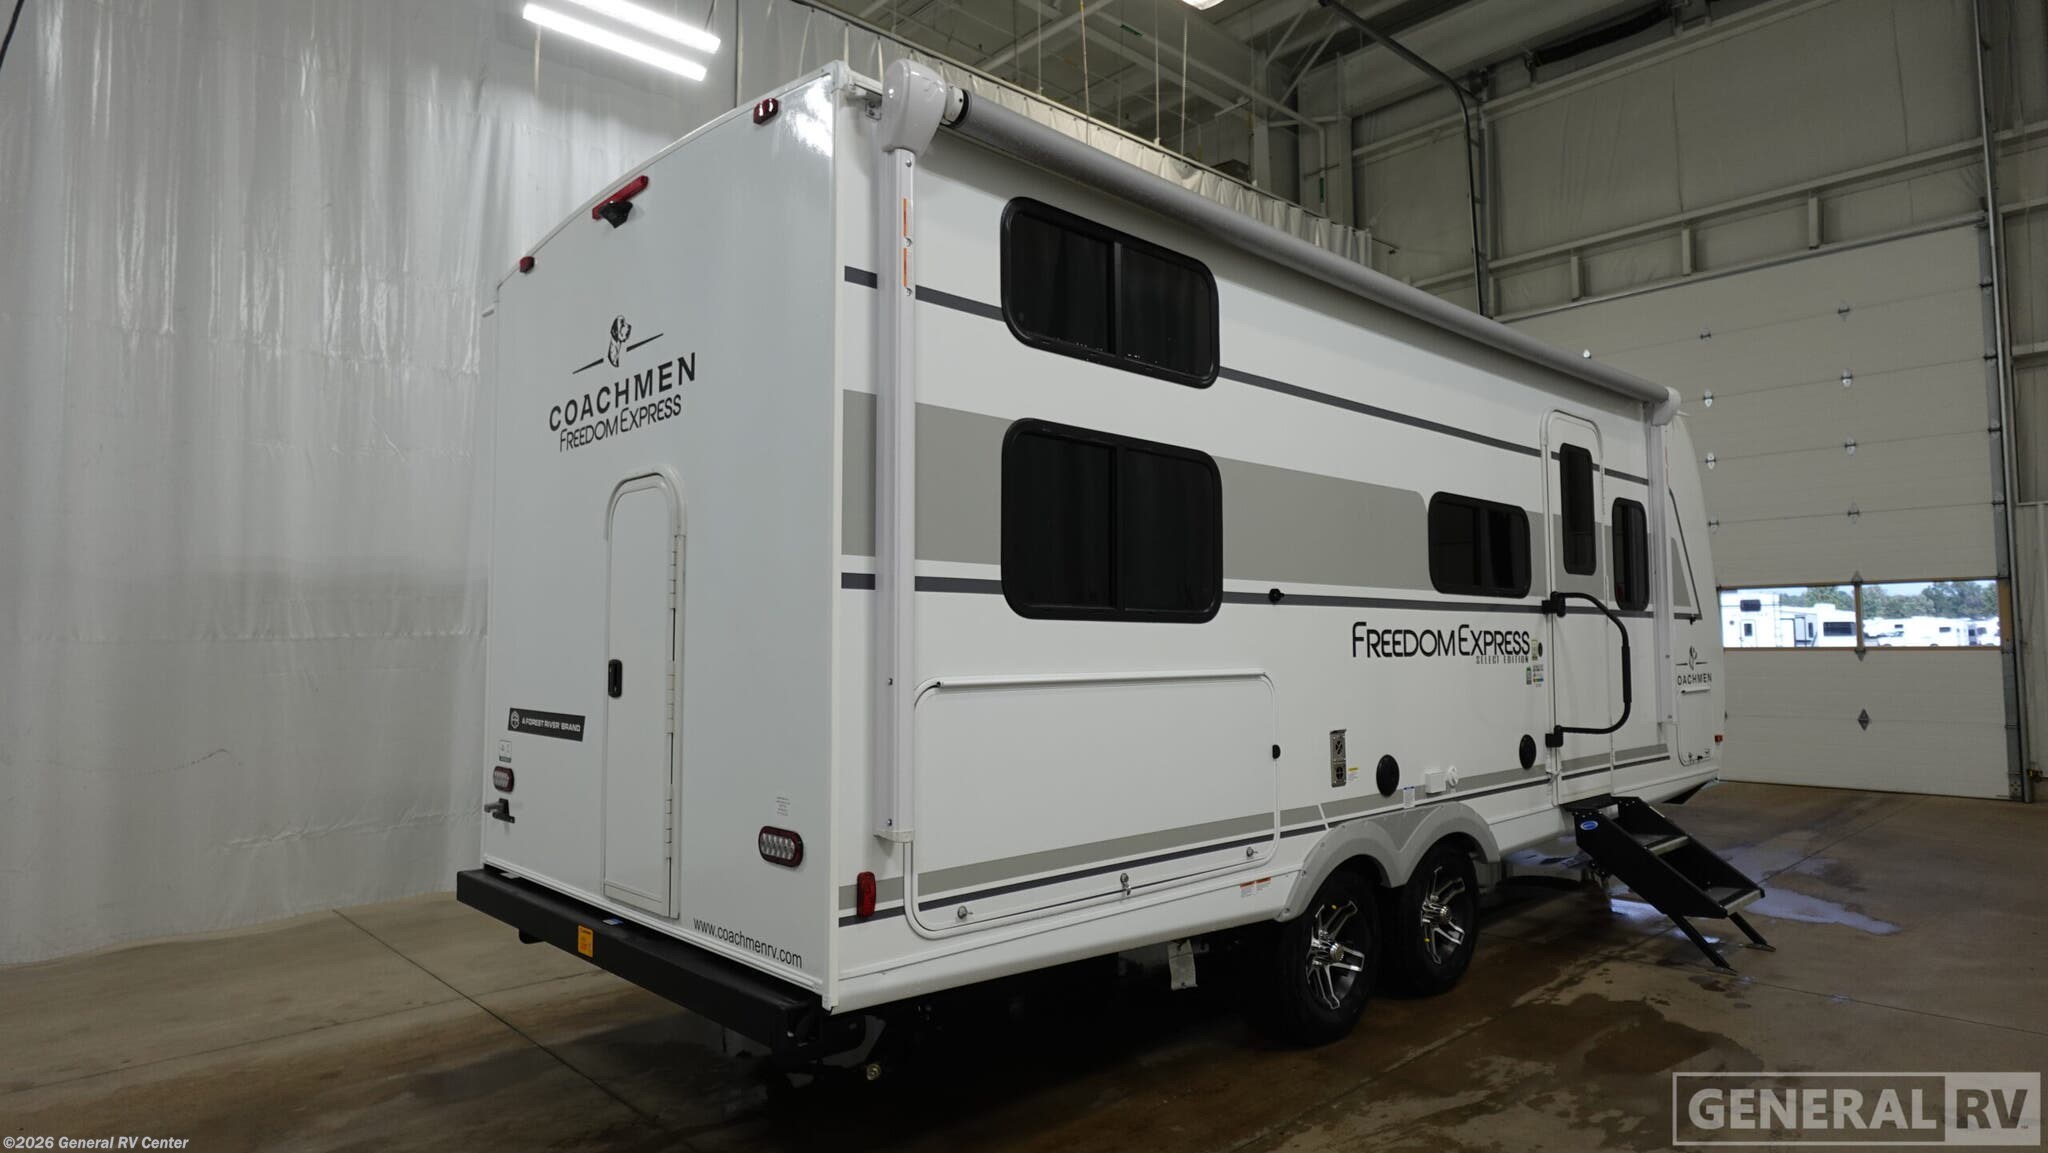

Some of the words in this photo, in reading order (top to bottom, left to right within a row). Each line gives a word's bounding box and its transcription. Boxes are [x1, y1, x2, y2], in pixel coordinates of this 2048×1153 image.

[549, 352, 696, 432] COACHMEN
[1475, 655, 1500, 664] SELECT
[1503, 655, 1529, 664] EDITION
[1677, 672, 1713, 686] OACHMEN
[526, 717, 544, 728] FOREST
[544, 720, 560, 730] RIVER
[561, 722, 581, 733] BRAND
[693, 918, 803, 968] www.coachmenrv.com
